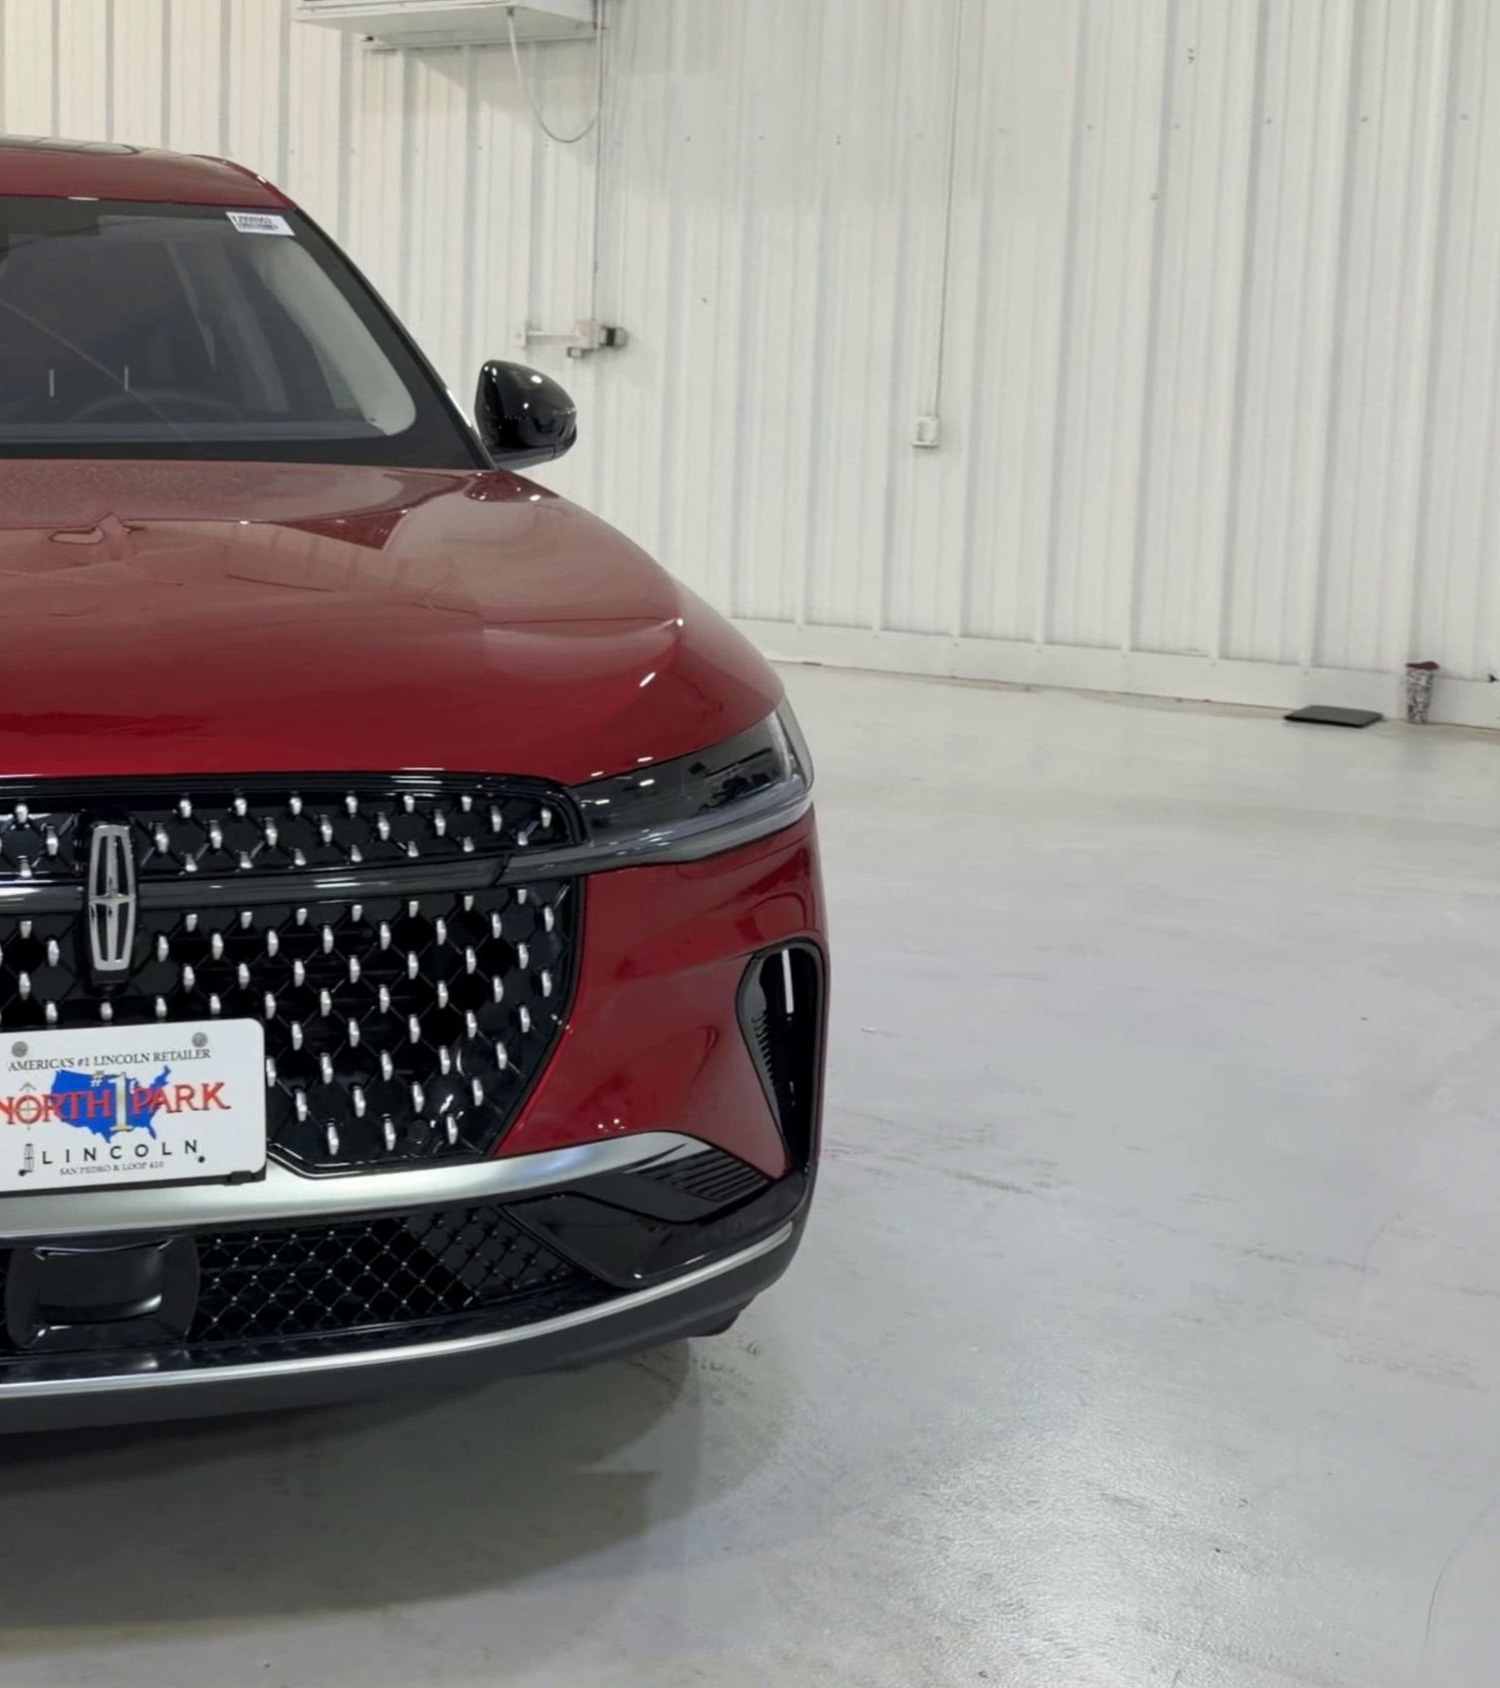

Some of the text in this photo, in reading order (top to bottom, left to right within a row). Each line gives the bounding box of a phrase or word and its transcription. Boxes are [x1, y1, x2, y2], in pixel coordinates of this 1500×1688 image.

[8, 1048, 211, 1071] AMERICA'S #1 LINCOLN RETAILER
[133, 1081, 232, 1116] PARK
[42, 1138, 199, 1165] LINCOLN
[59, 1167, 78, 1176] SAN
[79, 1165, 111, 1175] PEDRO
[122, 1162, 148, 1173] LOOP
